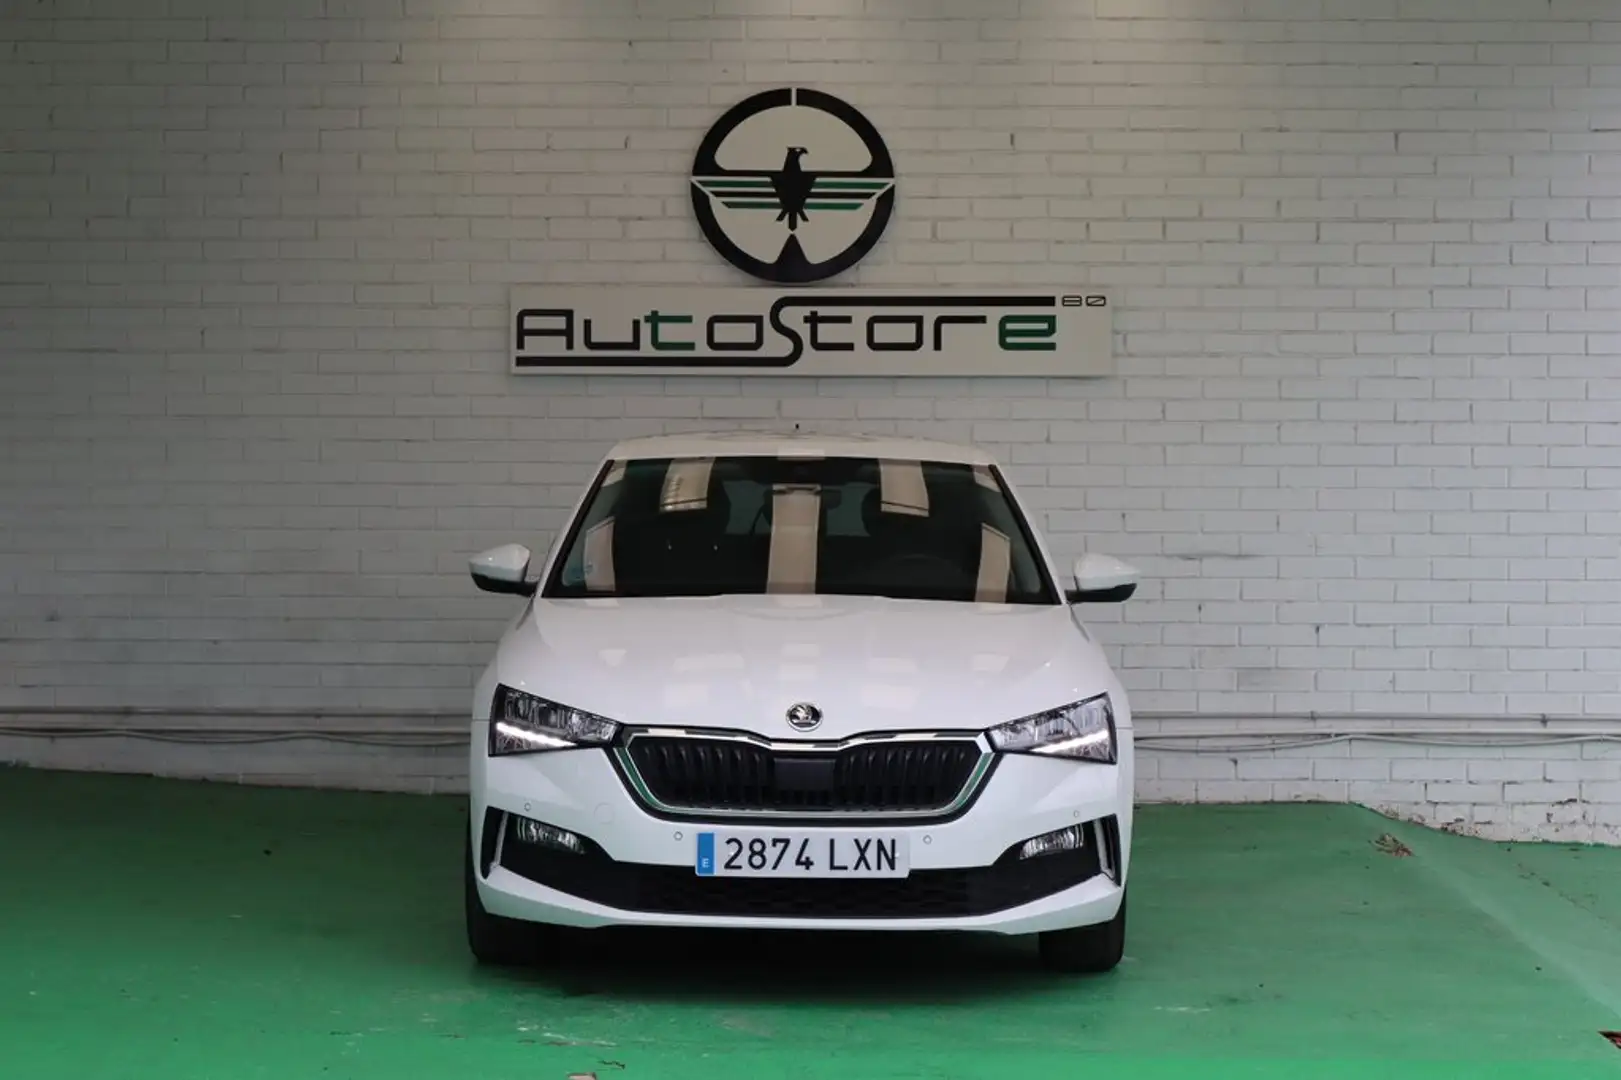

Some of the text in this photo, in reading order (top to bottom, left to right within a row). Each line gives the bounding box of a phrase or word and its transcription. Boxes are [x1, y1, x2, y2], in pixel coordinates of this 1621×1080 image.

[515, 295, 1106, 368] AutoStore 80
[702, 837, 897, 871] E 2874 LXN
